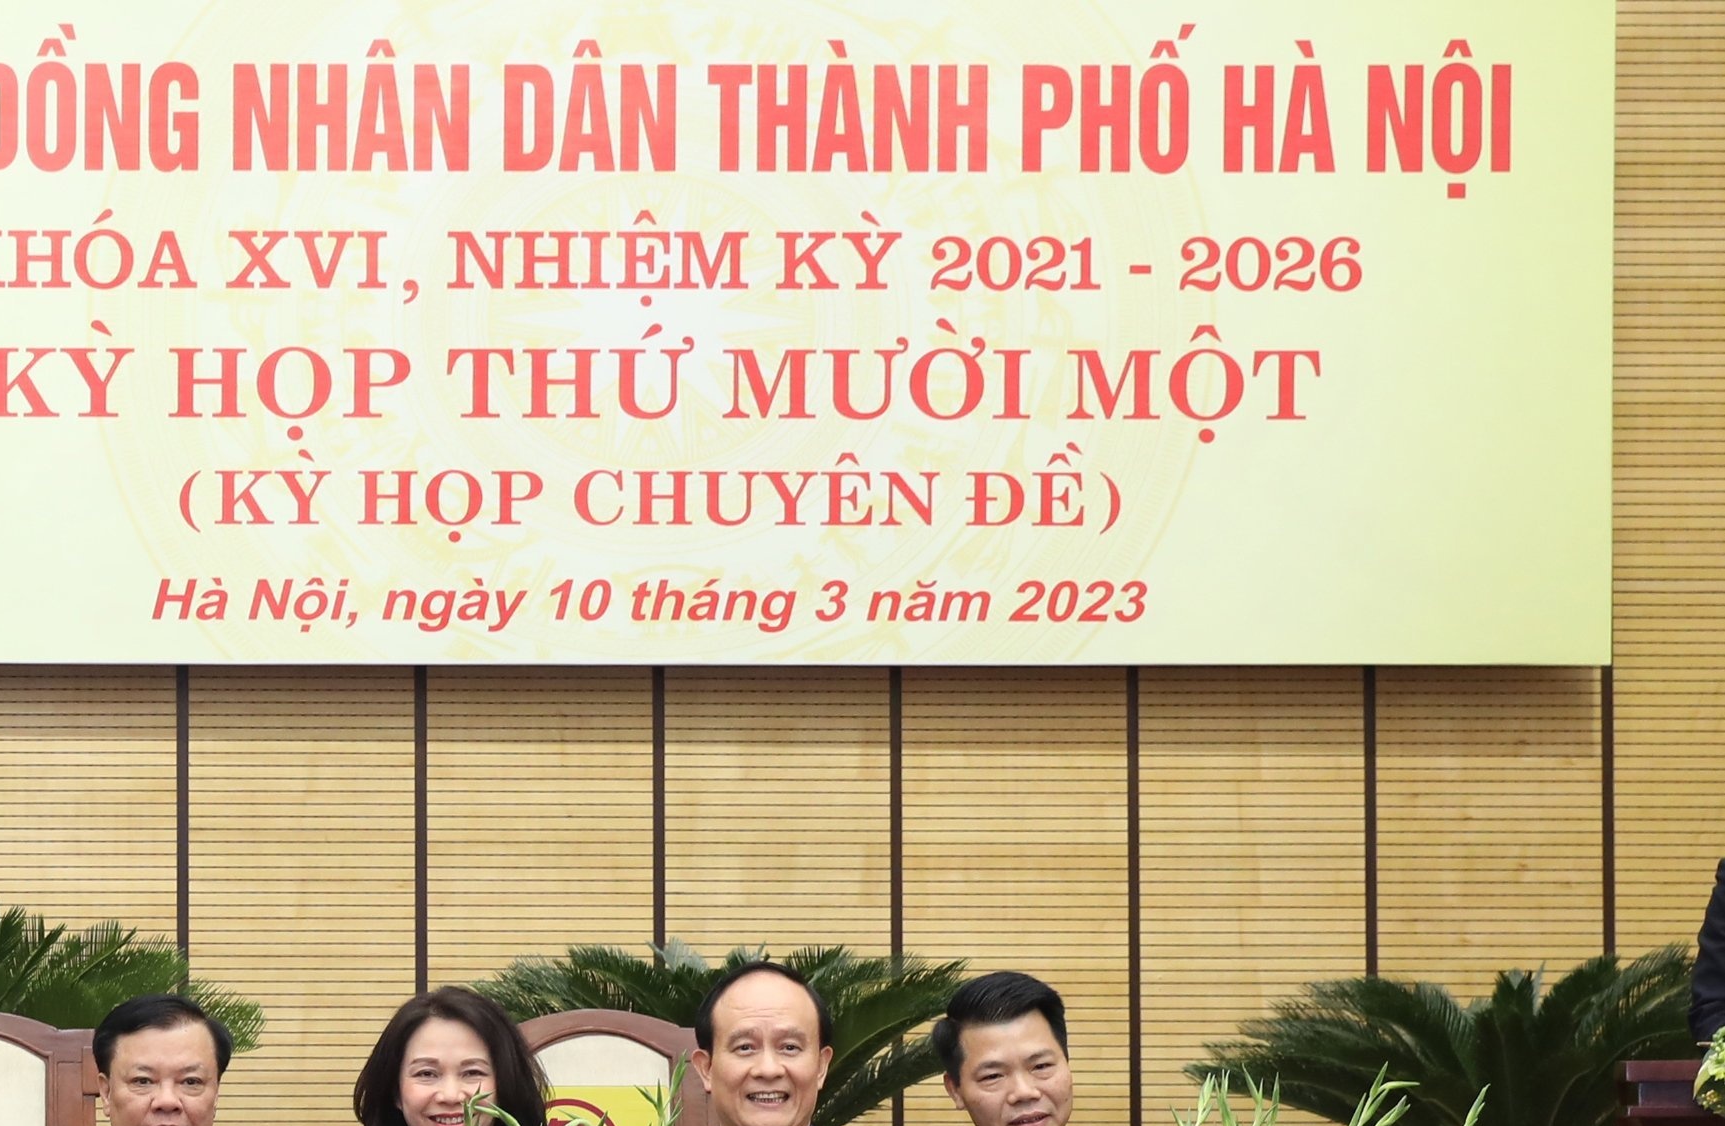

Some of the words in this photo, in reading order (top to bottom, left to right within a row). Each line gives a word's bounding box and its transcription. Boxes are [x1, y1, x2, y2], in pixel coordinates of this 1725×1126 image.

[233, 39, 471, 173] NHÂN
[503, 38, 678, 173] DÂN
[707, 38, 990, 174] THÀNH
[1021, 22, 1196, 176] PHỐ
[1222, 38, 1337, 174] HÀ
[1366, 38, 1513, 200] NỘI
[227, 229, 420, 304] XVI,
[447, 209, 750, 307] NHIỆM
[776, 210, 903, 291] KỲ
[930, 235, 1101, 293] 2021
[1129, 263, 1153, 276] -
[1179, 235, 1364, 293] 2026
[168, 345, 412, 442] HỌP
[446, 323, 696, 421] THỨ
[722, 317, 1030, 422] MƯỜI
[1067, 323, 1322, 446] MỘT
[178, 449, 331, 534] (KỲ
[359, 469, 544, 544] HỌP
[572, 451, 940, 528] CHUYÊN
[966, 442, 1123, 535] ĐỀ)
[152, 576, 229, 622] Hà
[248, 576, 358, 634] Nội,
[382, 577, 528, 634] ngày
[550, 578, 613, 622] 10
[631, 577, 797, 634] tháng
[815, 578, 850, 623] 3
[866, 578, 992, 623] năm
[1009, 579, 1149, 624] 2023
